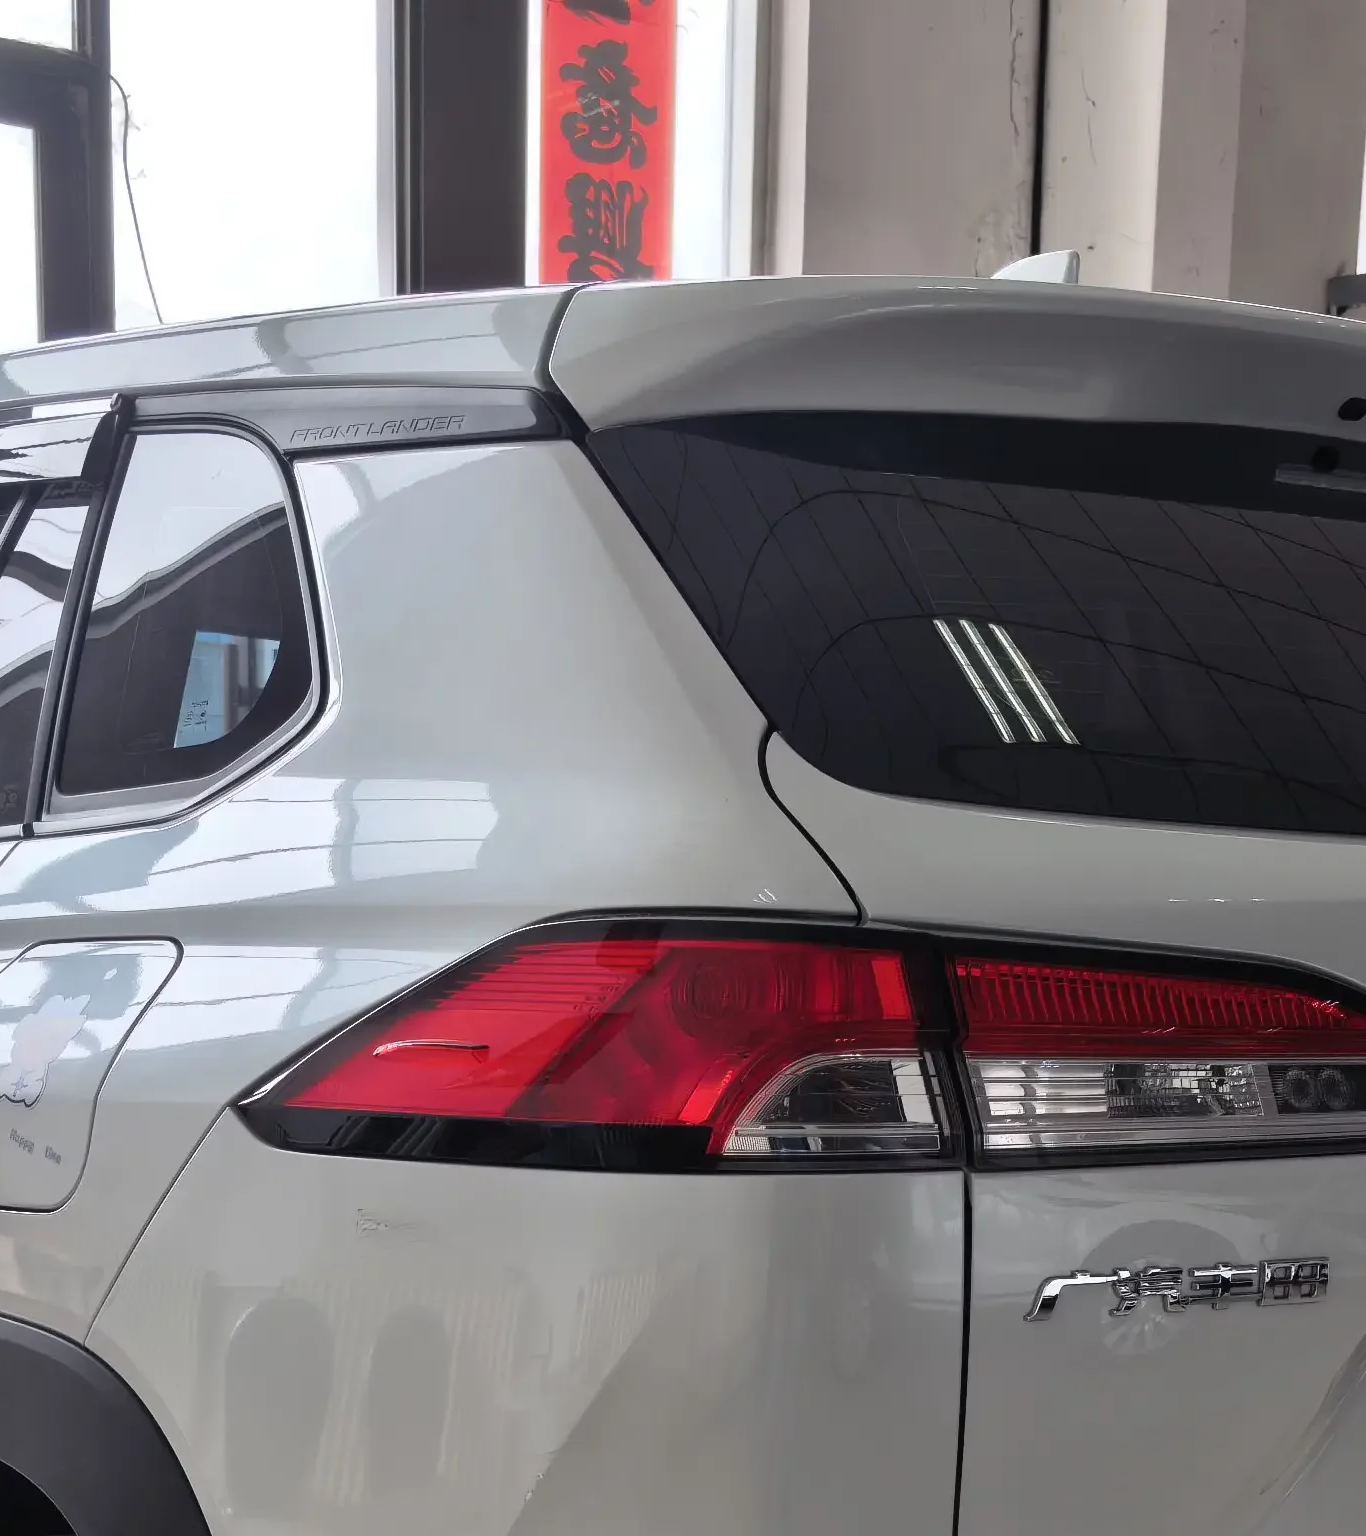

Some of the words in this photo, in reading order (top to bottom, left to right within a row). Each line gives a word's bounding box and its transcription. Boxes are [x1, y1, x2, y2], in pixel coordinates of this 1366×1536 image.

[289, 414, 466, 443] FRONTLANDER
[1022, 1256, 1331, 1322] 广汽丰田
